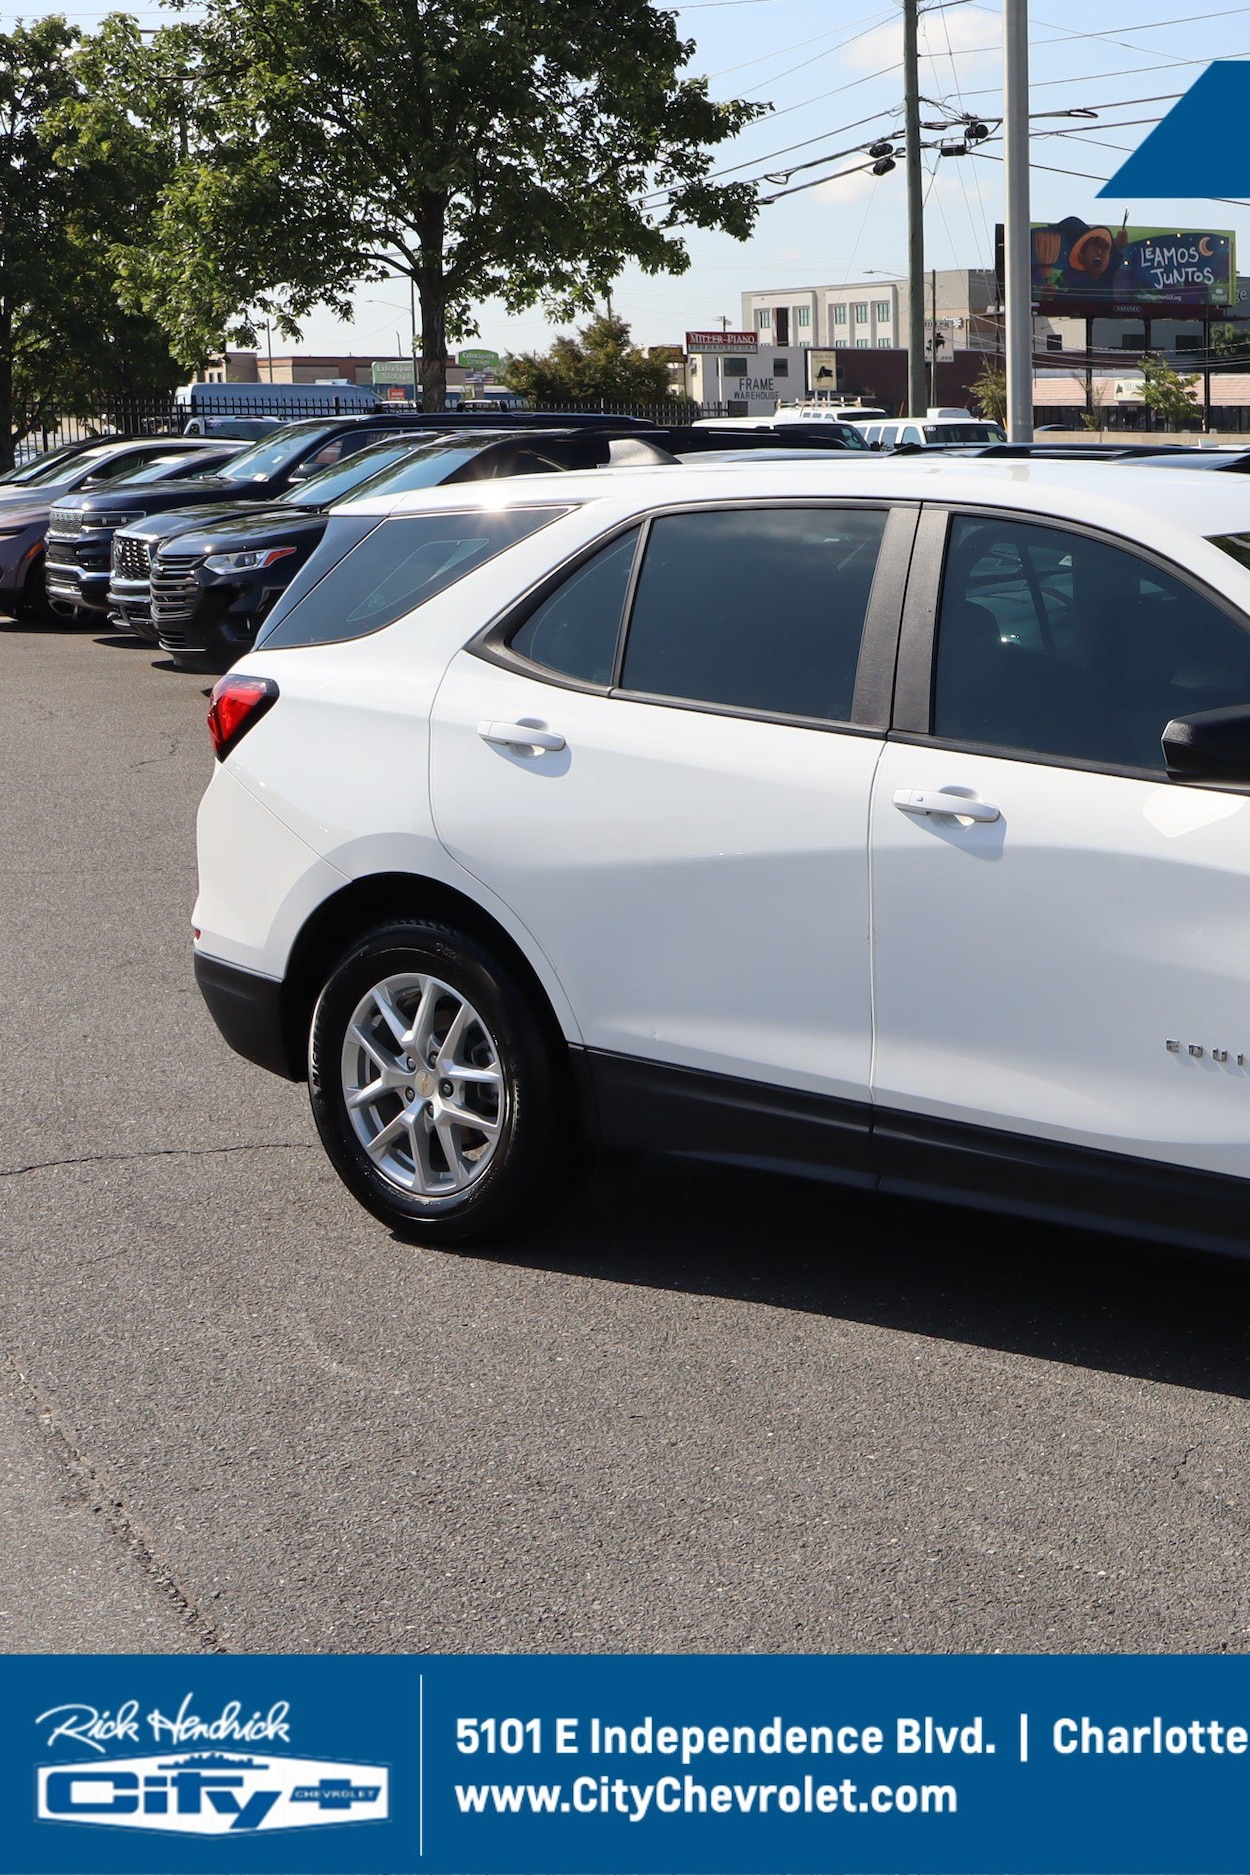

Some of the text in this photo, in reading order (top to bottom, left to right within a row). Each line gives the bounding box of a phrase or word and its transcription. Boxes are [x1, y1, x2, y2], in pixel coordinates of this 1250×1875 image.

[1141, 247, 1199, 267] LEAMOS
[739, 378, 775, 391] FRAME
[733, 391, 780, 400] WAREHOUSE
